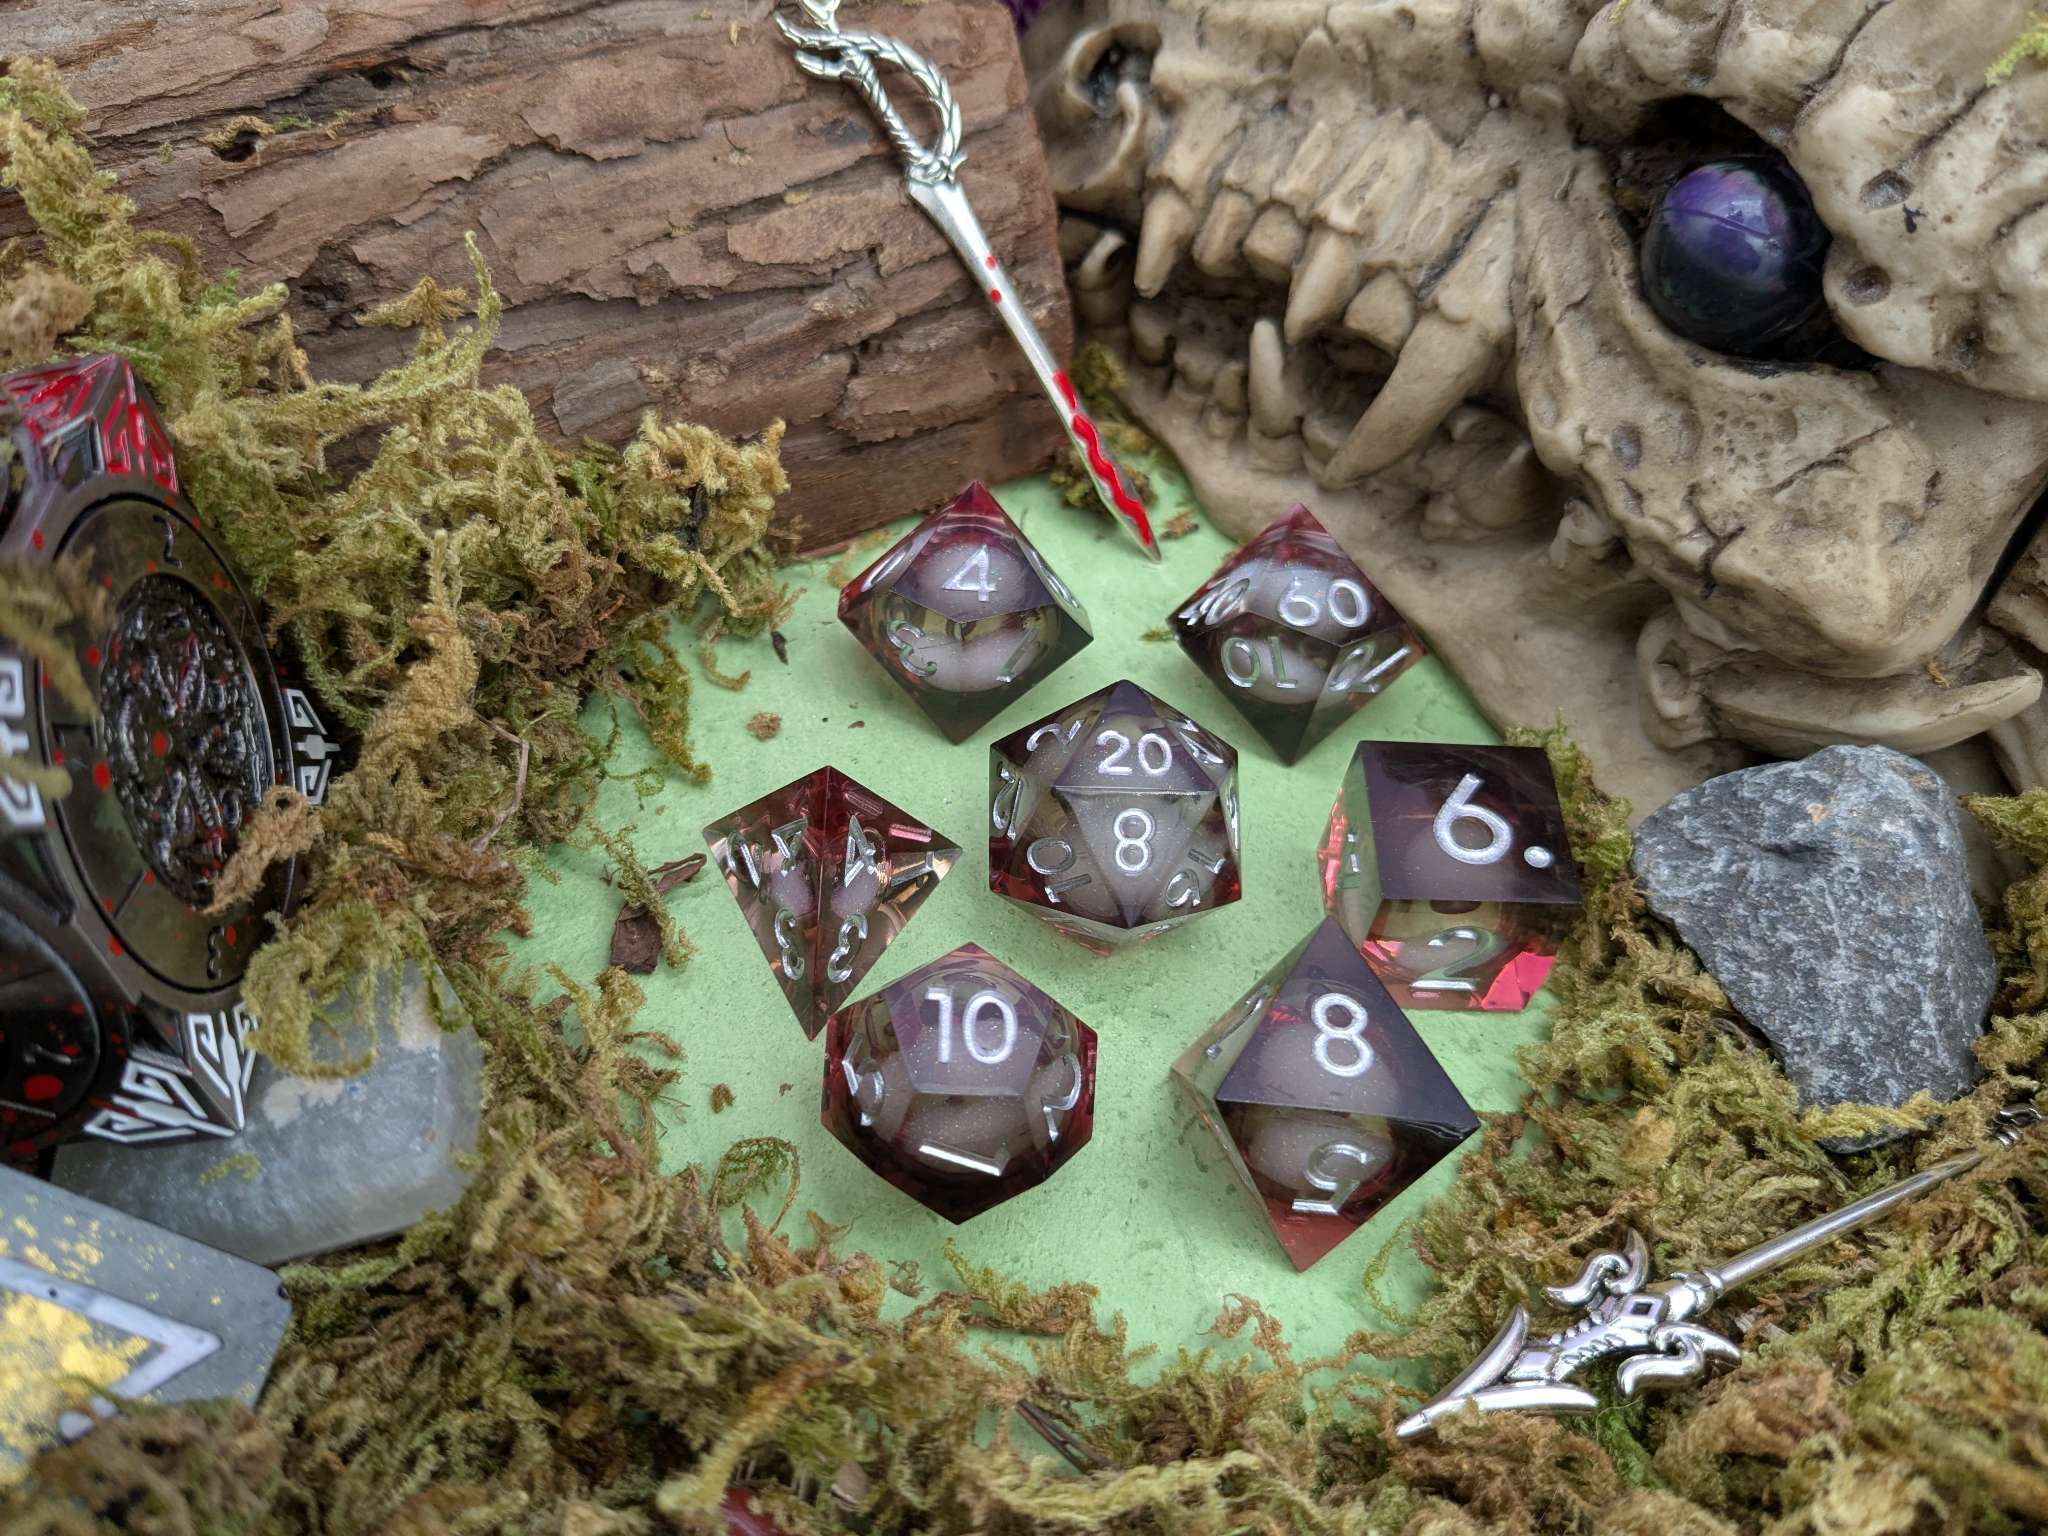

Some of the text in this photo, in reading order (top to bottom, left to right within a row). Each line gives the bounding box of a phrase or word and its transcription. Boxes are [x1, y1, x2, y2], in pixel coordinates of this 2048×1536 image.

[943, 544, 997, 602] 4
[1278, 576, 1371, 628] 60
[1220, 636, 1298, 689] 10
[1096, 730, 1173, 776] 20
[1113, 808, 1155, 873] 8
[1409, 926, 1498, 991] 2
[925, 986, 1018, 1064] 10
[1311, 993, 1375, 1077] 8
[1292, 1140, 1373, 1216] 5
